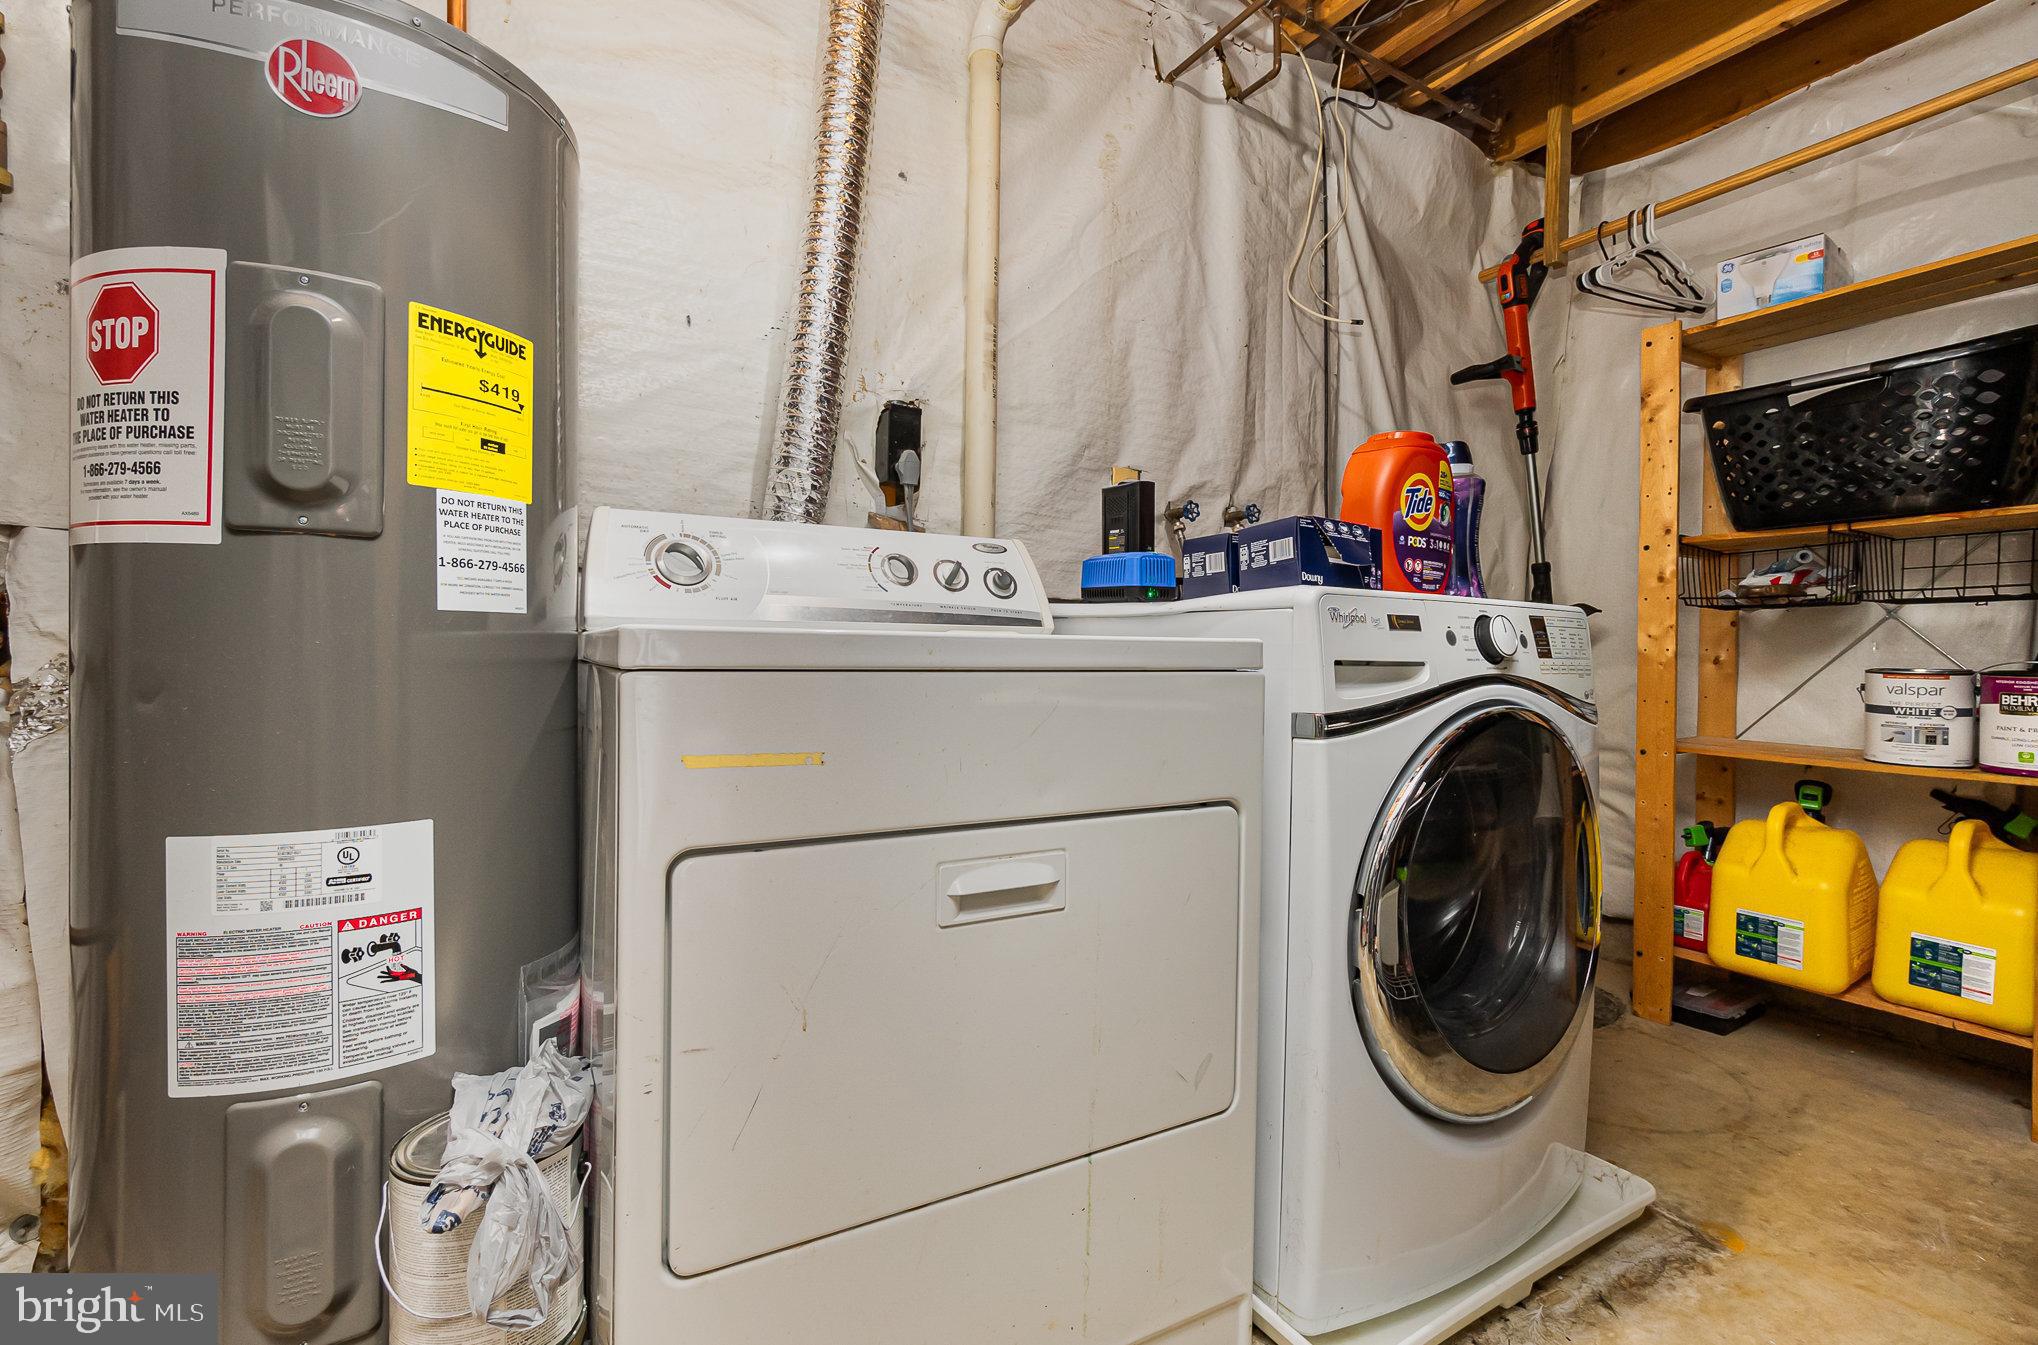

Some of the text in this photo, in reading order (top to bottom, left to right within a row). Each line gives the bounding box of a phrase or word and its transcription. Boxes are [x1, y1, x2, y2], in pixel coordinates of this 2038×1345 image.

[212, 0, 422, 68] PERFORMANCE
[278, 39, 356, 102] Rheem
[91, 316, 149, 352] STOP
[418, 311, 527, 360] ENERGYGUIDE
[479, 379, 520, 402] $419
[77, 390, 180, 411] DO NOT RETURN THIS
[80, 407, 170, 427] WATER HEATER TO
[82, 426, 106, 443] PLACE
[109, 425, 122, 440] OF
[125, 425, 195, 440] PURCHASE
[83, 461, 161, 478] 1-866-279-4566
[441, 496, 523, 516] DO NOT RETURN THIS
[1404, 486, 1434, 519] Tide
[438, 508, 525, 526] WATER HEATER TO THE
[444, 520, 522, 536] PLACE OF PURCHASE
[1408, 536, 1427, 548] PODS
[438, 556, 525, 574] 1-866-279-4566
[1302, 571, 1324, 585] Downy
[1329, 608, 1367, 628] Whirlpool
[1886, 682, 1946, 698] valspar
[2001, 694, 2038, 706] BEHR
[1893, 707, 1937, 716] WHITE
[342, 850, 354, 860] UL
[300, 921, 332, 930] CAUTION
[358, 910, 418, 928] DANGER
[388, 954, 406, 963] HOT
